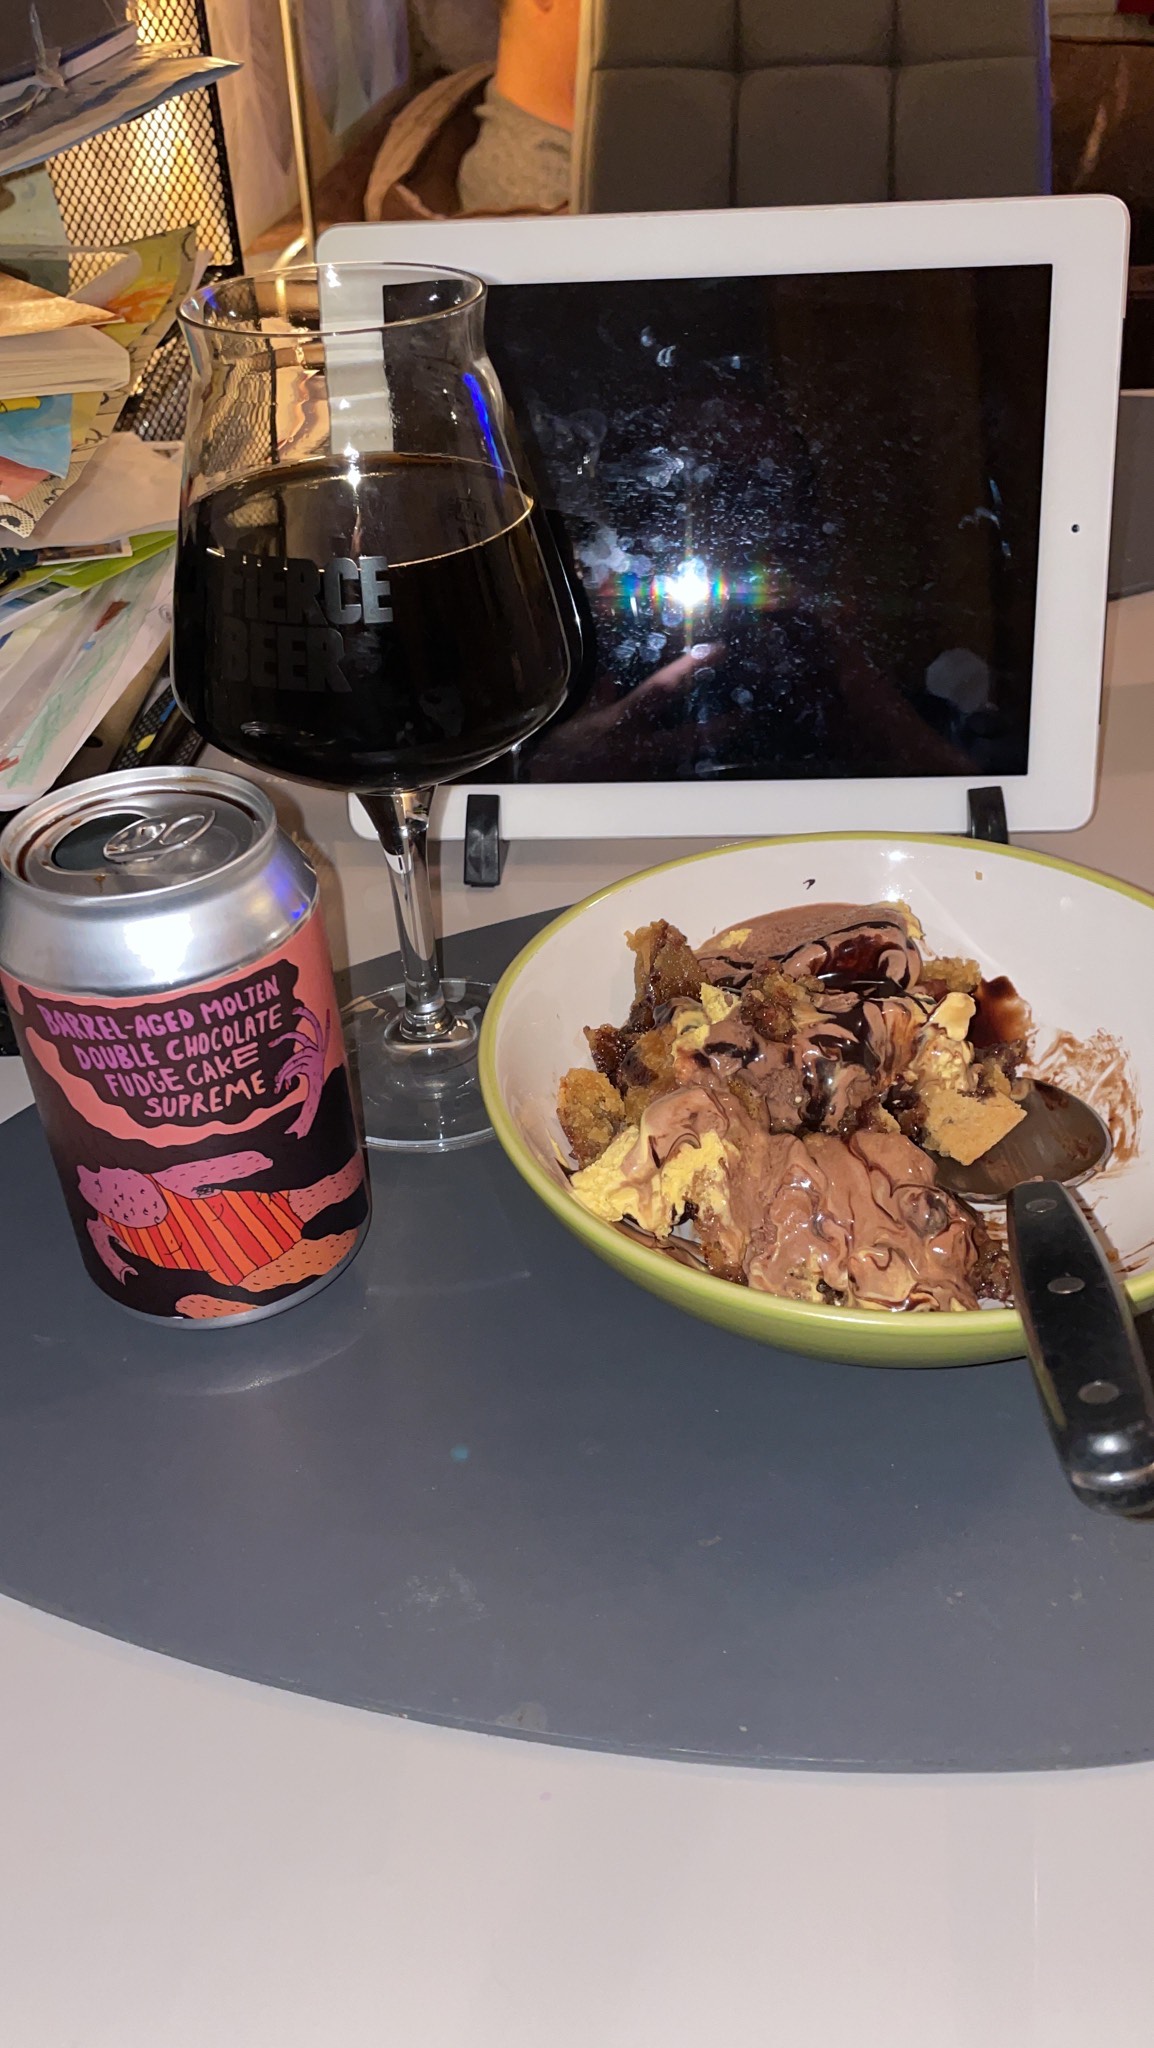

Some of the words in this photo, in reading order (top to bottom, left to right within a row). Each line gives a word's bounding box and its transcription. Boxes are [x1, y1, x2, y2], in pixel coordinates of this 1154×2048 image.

[222, 555, 394, 625] FIERCE
[222, 617, 352, 692] BEER
[37, 1003, 195, 1041] BARREL-AGED
[201, 975, 280, 1023] MOLTEN
[73, 1043, 159, 1070] DOUBLE
[166, 1003, 283, 1061] CHOCOLATE
[104, 1067, 184, 1097] FUDGE
[186, 1042, 260, 1085] CAKE
[144, 1070, 267, 1118] SUPREME
